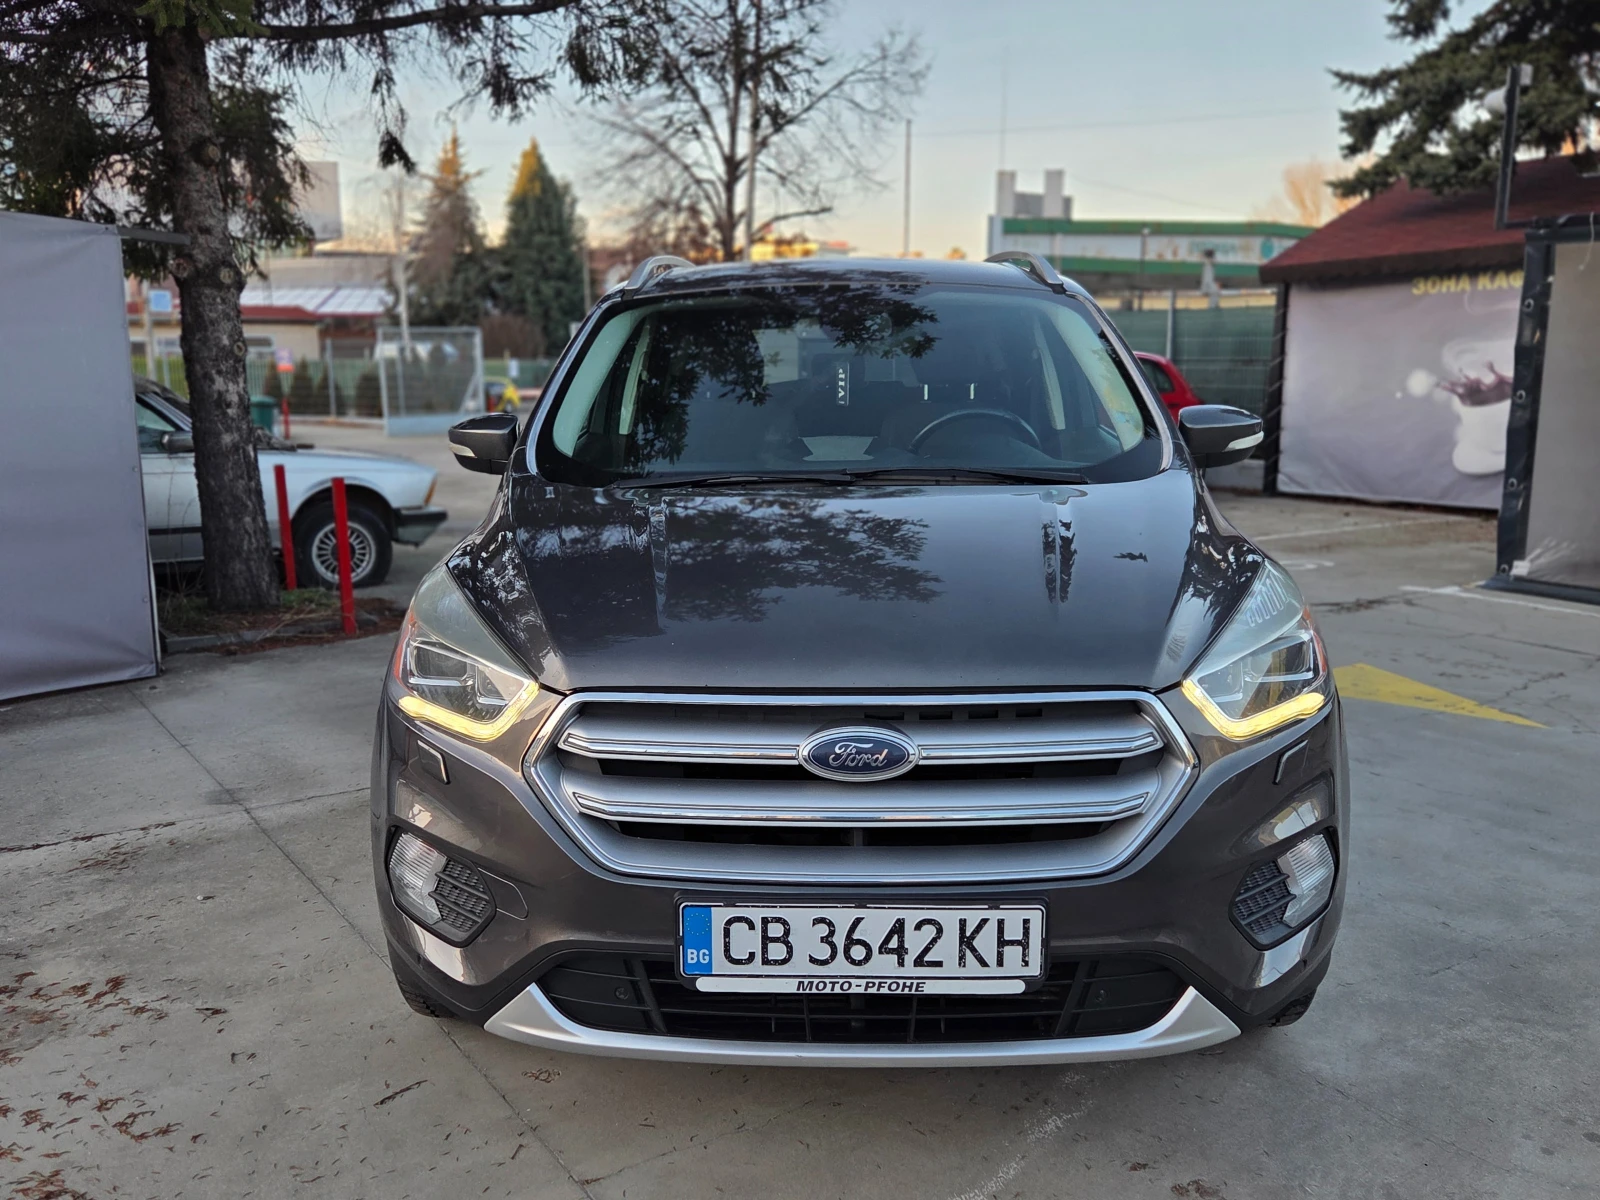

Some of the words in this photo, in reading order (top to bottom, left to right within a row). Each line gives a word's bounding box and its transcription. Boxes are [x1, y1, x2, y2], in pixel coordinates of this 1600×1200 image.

[1411, 274, 1471, 295] ЗОНА
[828, 742, 888, 767] Ford
[722, 915, 794, 967] CB
[807, 916, 944, 968] 3642
[957, 917, 1031, 968] KH
[686, 949, 710, 964] BG
[796, 980, 926, 993] MOTO-PFOHE
